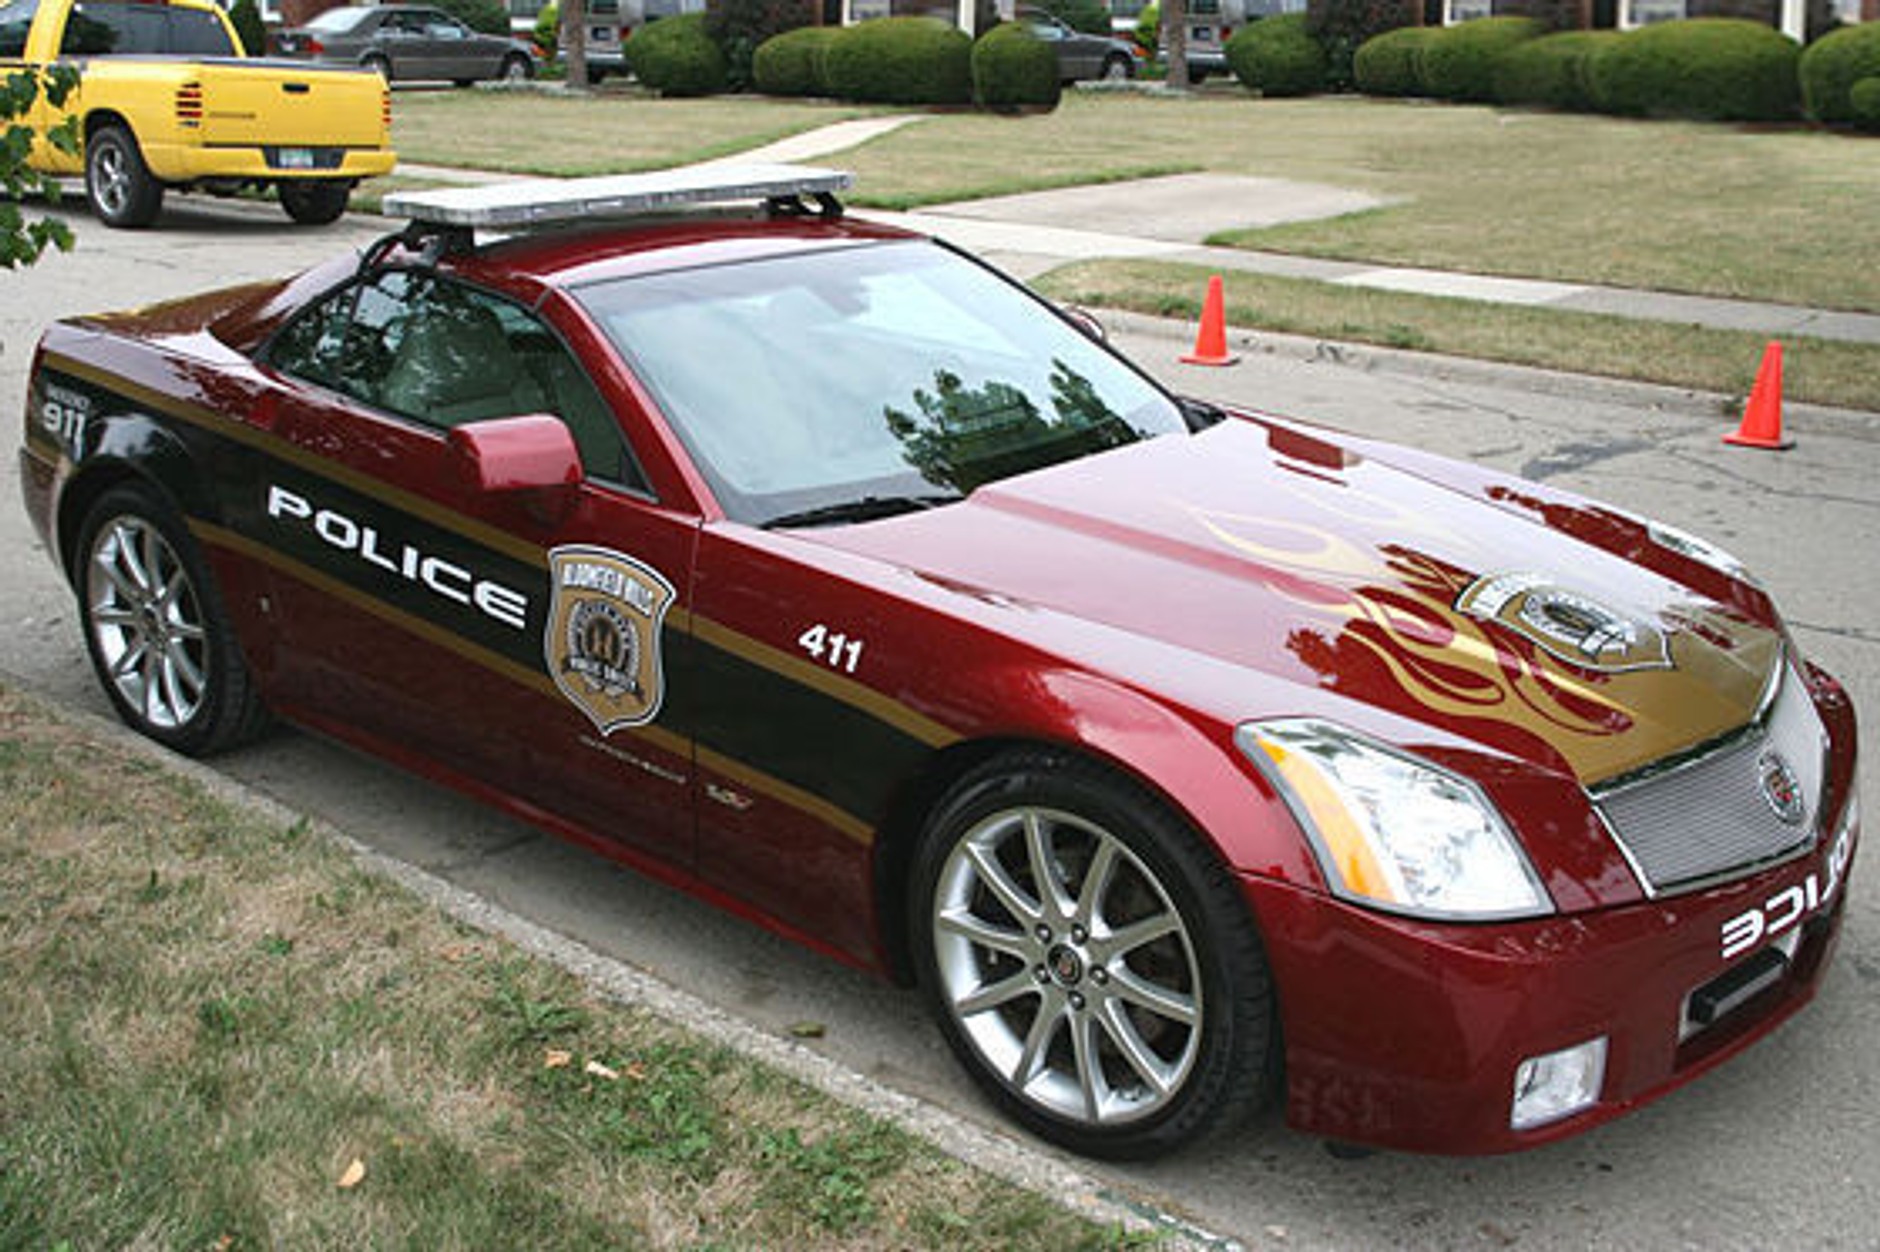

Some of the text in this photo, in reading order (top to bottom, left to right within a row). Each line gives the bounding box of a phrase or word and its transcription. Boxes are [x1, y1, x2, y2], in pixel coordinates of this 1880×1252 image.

[43, 402, 86, 443] 911
[268, 485, 527, 629] POLICE
[798, 623, 862, 673] 411
